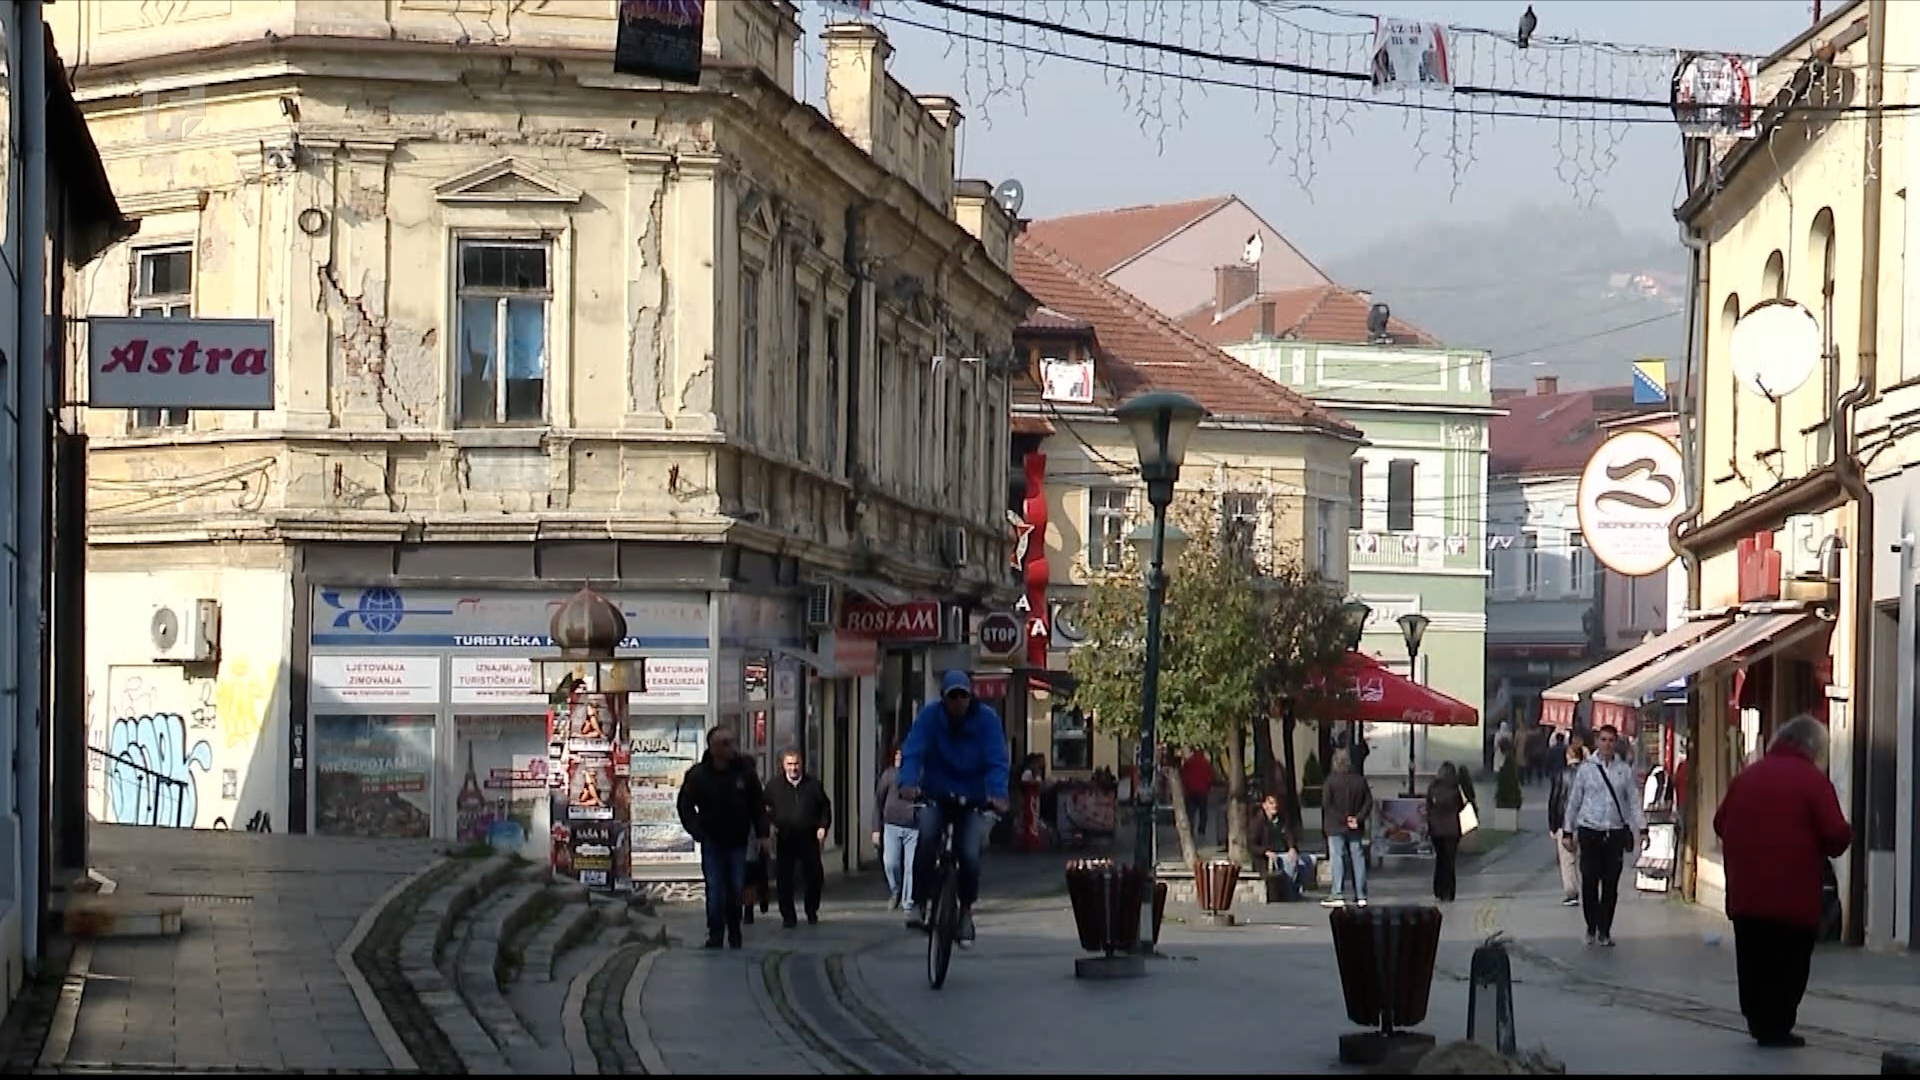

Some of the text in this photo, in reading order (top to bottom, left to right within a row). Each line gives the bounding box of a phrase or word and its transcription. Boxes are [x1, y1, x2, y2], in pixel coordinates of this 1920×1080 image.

[101, 340, 267, 375] Astra
[983, 627, 1016, 642] STOP
[453, 635, 542, 647] TURISTIČKA
[346, 663, 405, 672] LJETOVANJA
[349, 676, 402, 684] ZIMOVANJA
